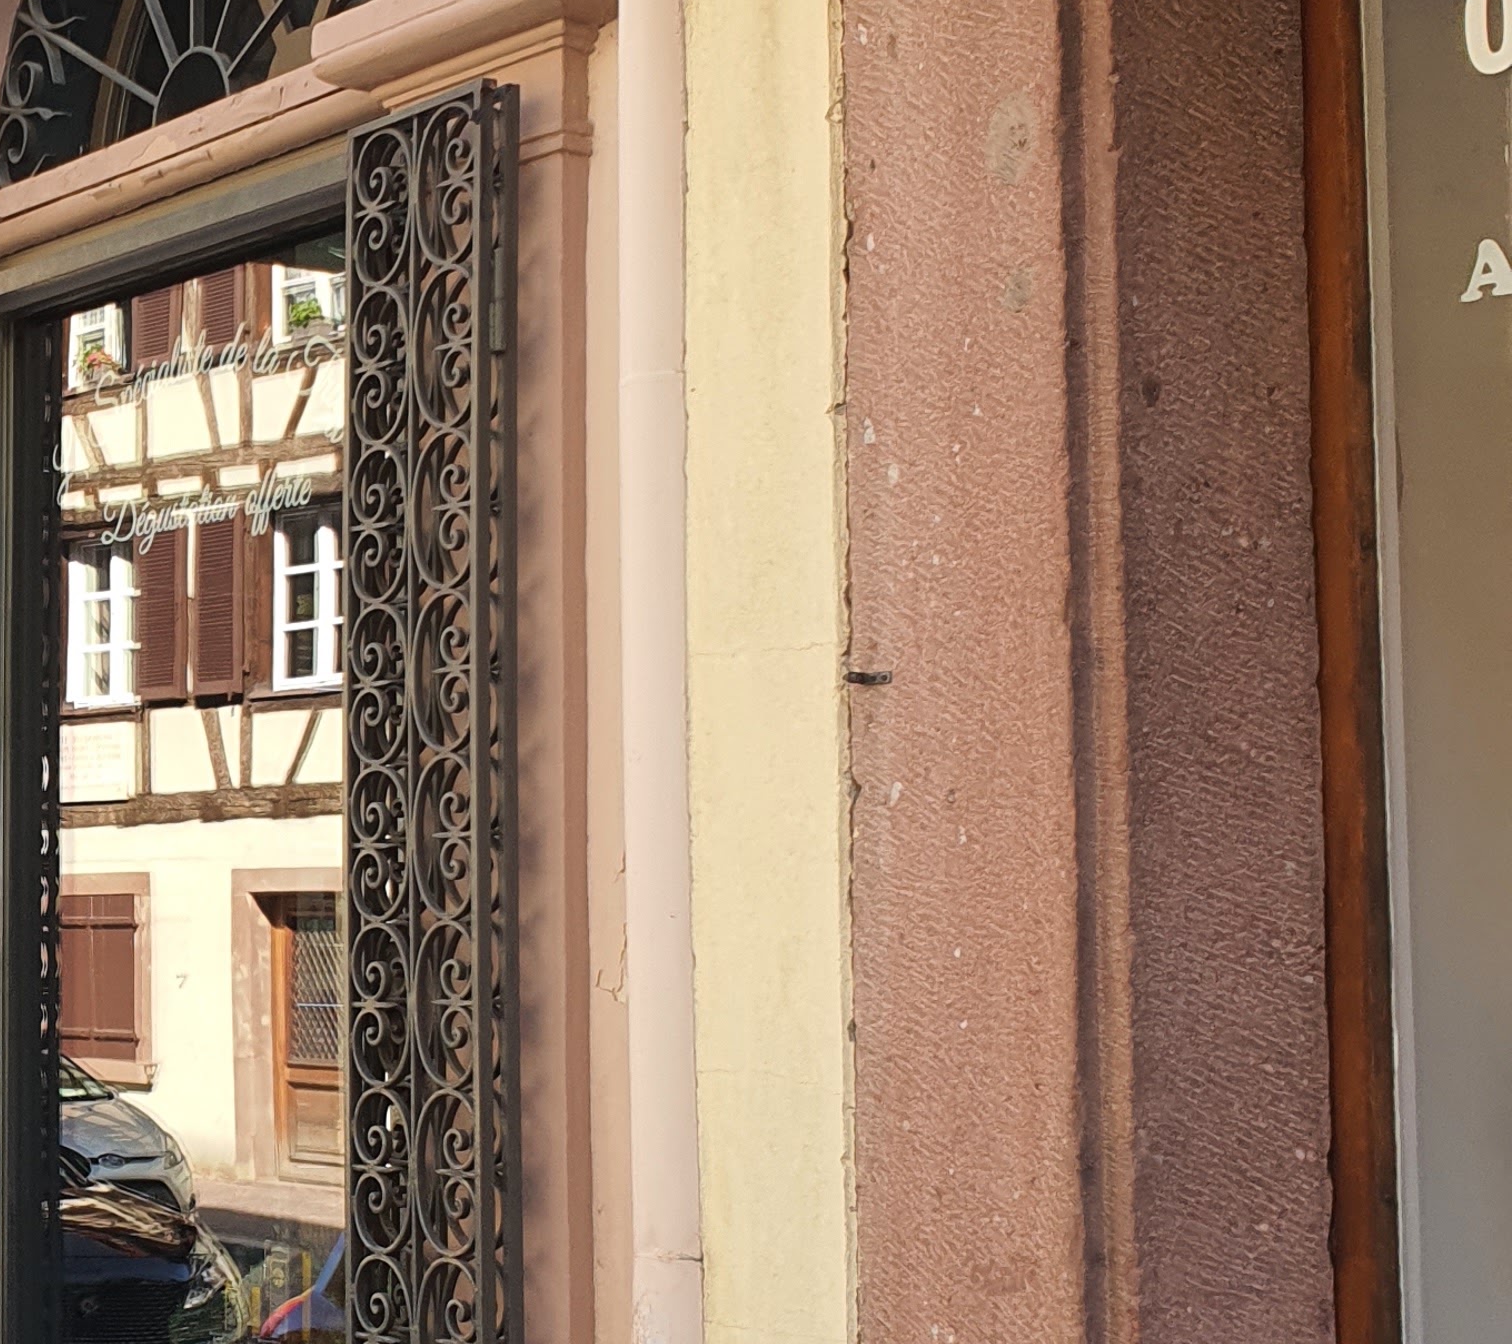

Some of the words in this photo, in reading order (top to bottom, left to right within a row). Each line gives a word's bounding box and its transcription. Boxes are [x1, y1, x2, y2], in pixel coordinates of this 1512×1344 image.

[219, 321, 249, 373] de
[252, 325, 281, 375] la
[100, 484, 240, 555] Dégustation
[243, 468, 313, 537] offerte
